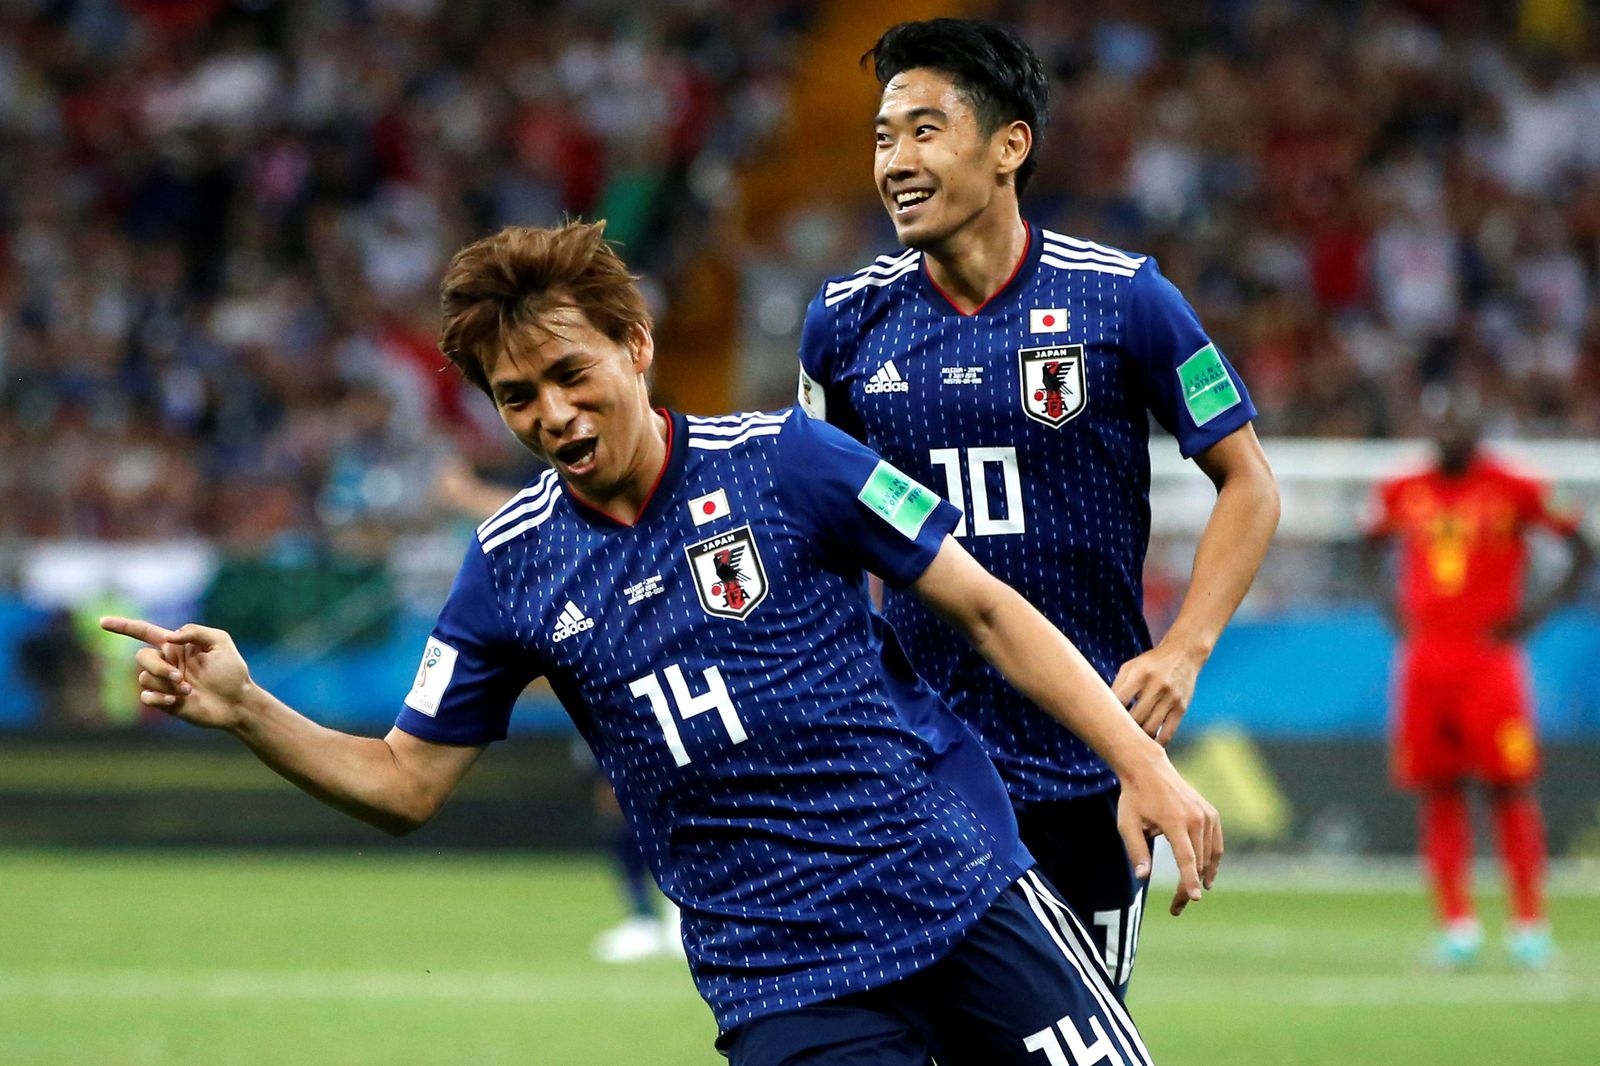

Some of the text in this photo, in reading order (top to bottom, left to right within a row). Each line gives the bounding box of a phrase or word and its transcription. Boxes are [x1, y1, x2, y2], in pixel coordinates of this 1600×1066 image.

[1035, 349, 1067, 358] JAPAN
[865, 380, 909, 394] adidas
[1041, 400, 1069, 413] JFA
[930, 446, 1026, 537] 10
[703, 534, 736, 552] JAPAN
[722, 588, 751, 608] JFA
[552, 617, 594, 642] adidas
[628, 663, 748, 768] 14
[1094, 887, 1144, 985] 10
